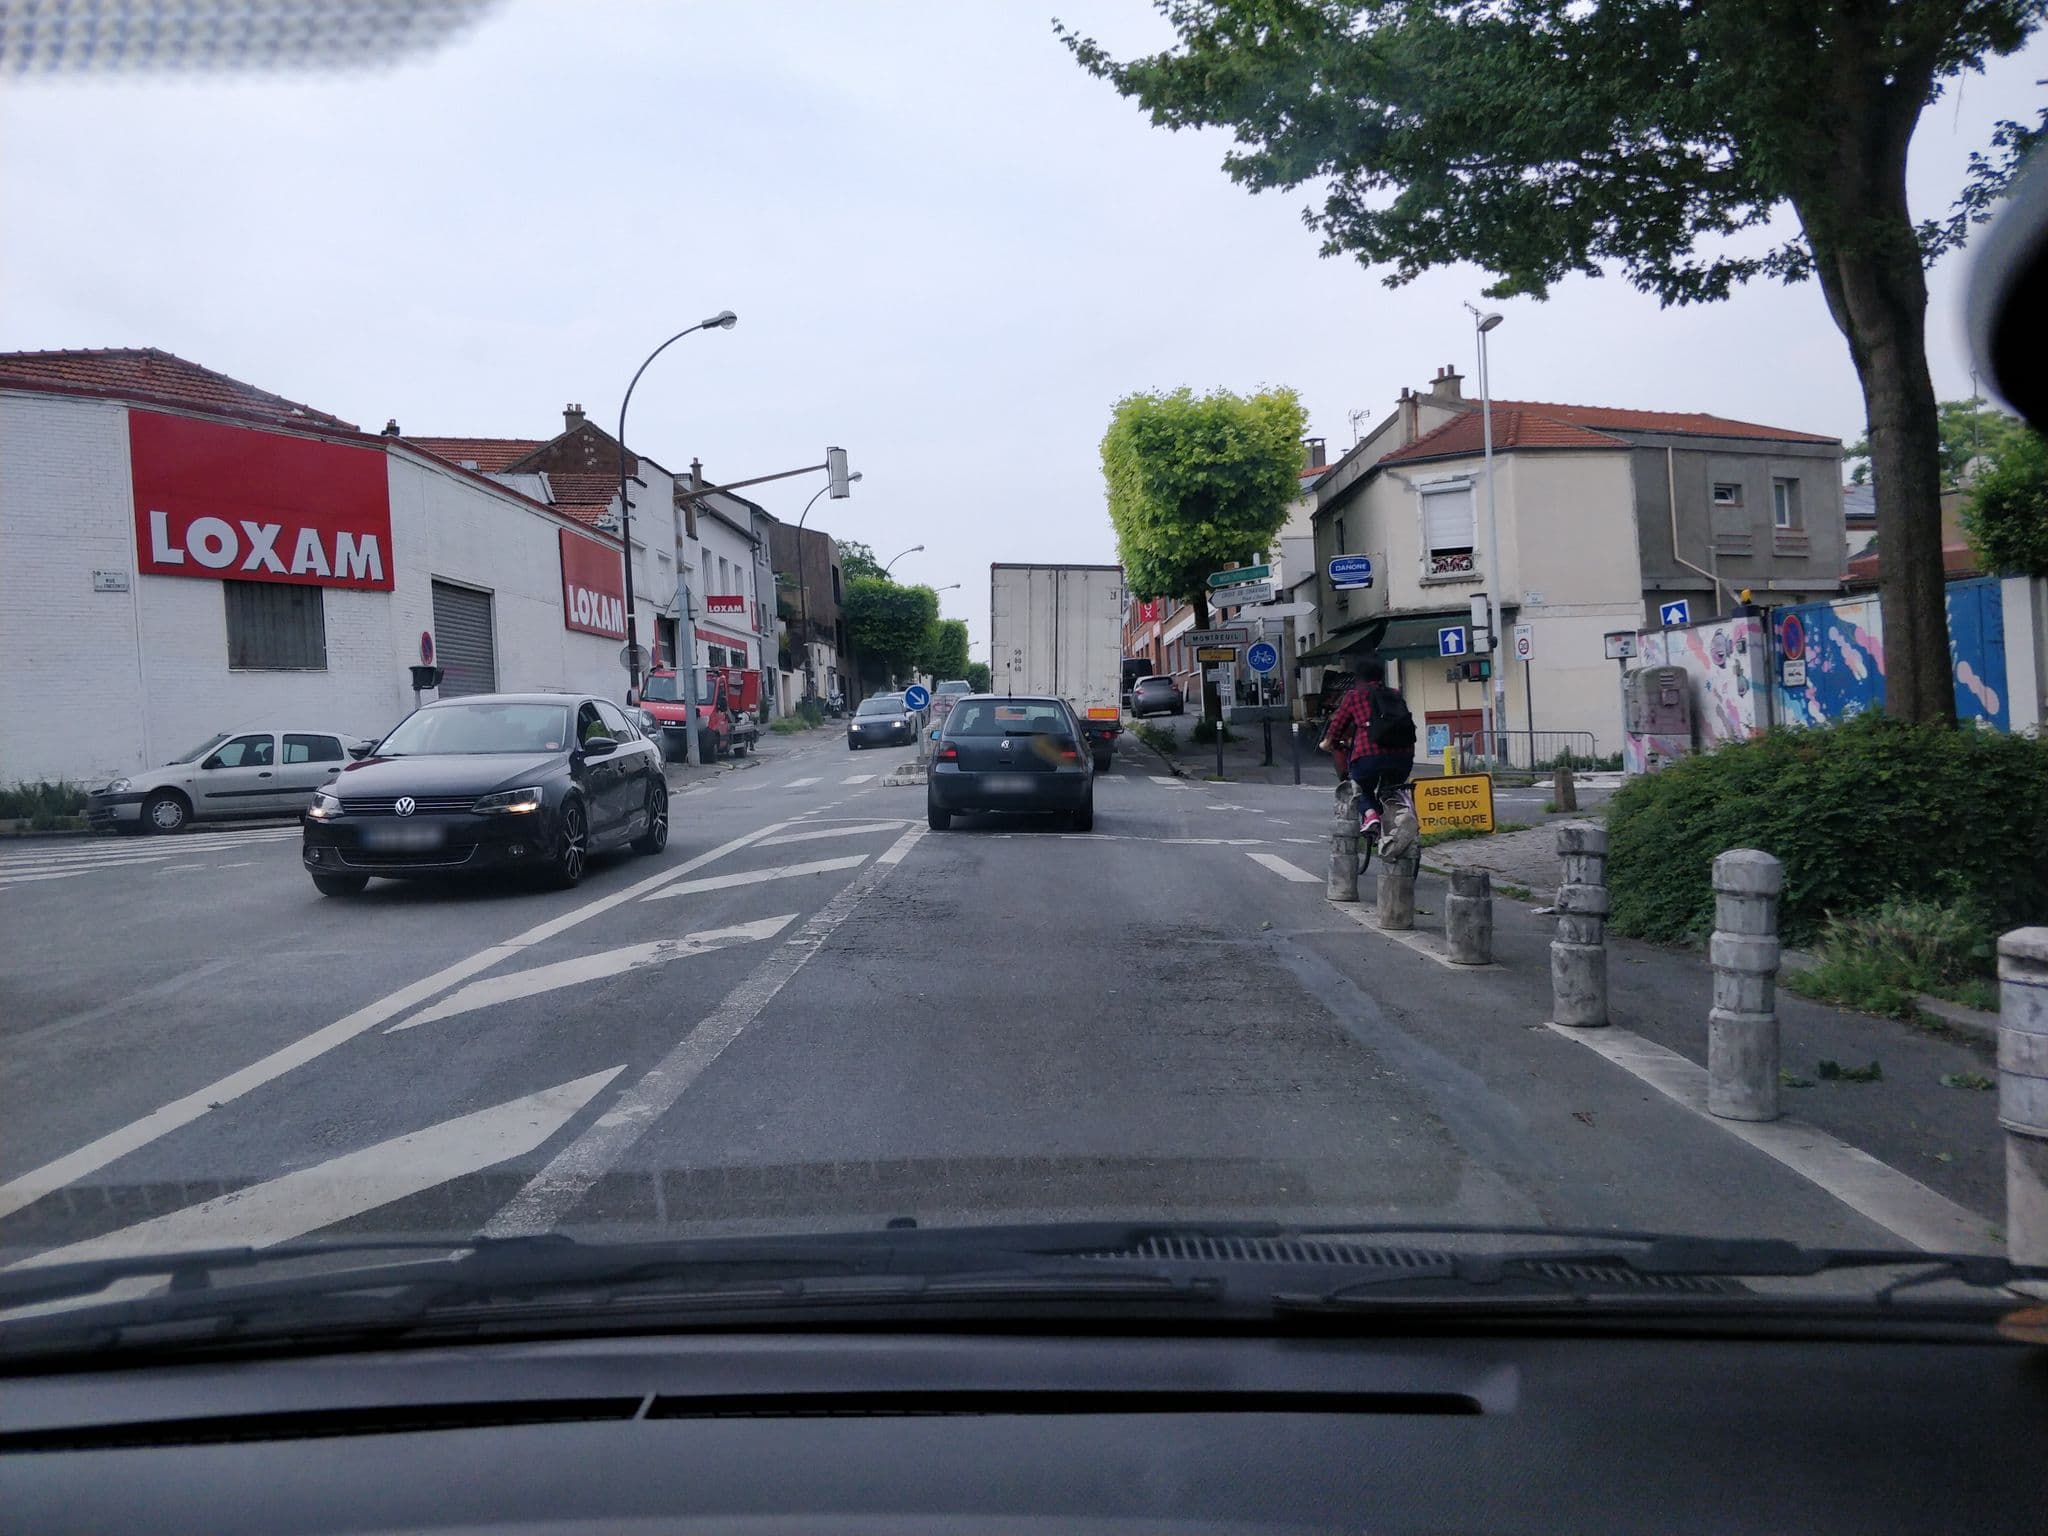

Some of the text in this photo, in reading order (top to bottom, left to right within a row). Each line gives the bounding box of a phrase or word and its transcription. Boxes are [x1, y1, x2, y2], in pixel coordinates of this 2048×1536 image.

[149, 510, 384, 581] LOXAM
[1335, 563, 1367, 572] DANONE
[568, 584, 624, 633] LOXAM
[708, 604, 743, 613] LOXAM
[1192, 634, 1239, 642] MONTREUIL
[1424, 784, 1479, 797] ABSENCE
[1428, 799, 1478, 812] DE FEUX
[1421, 814, 1488, 827] TRICOLORE
